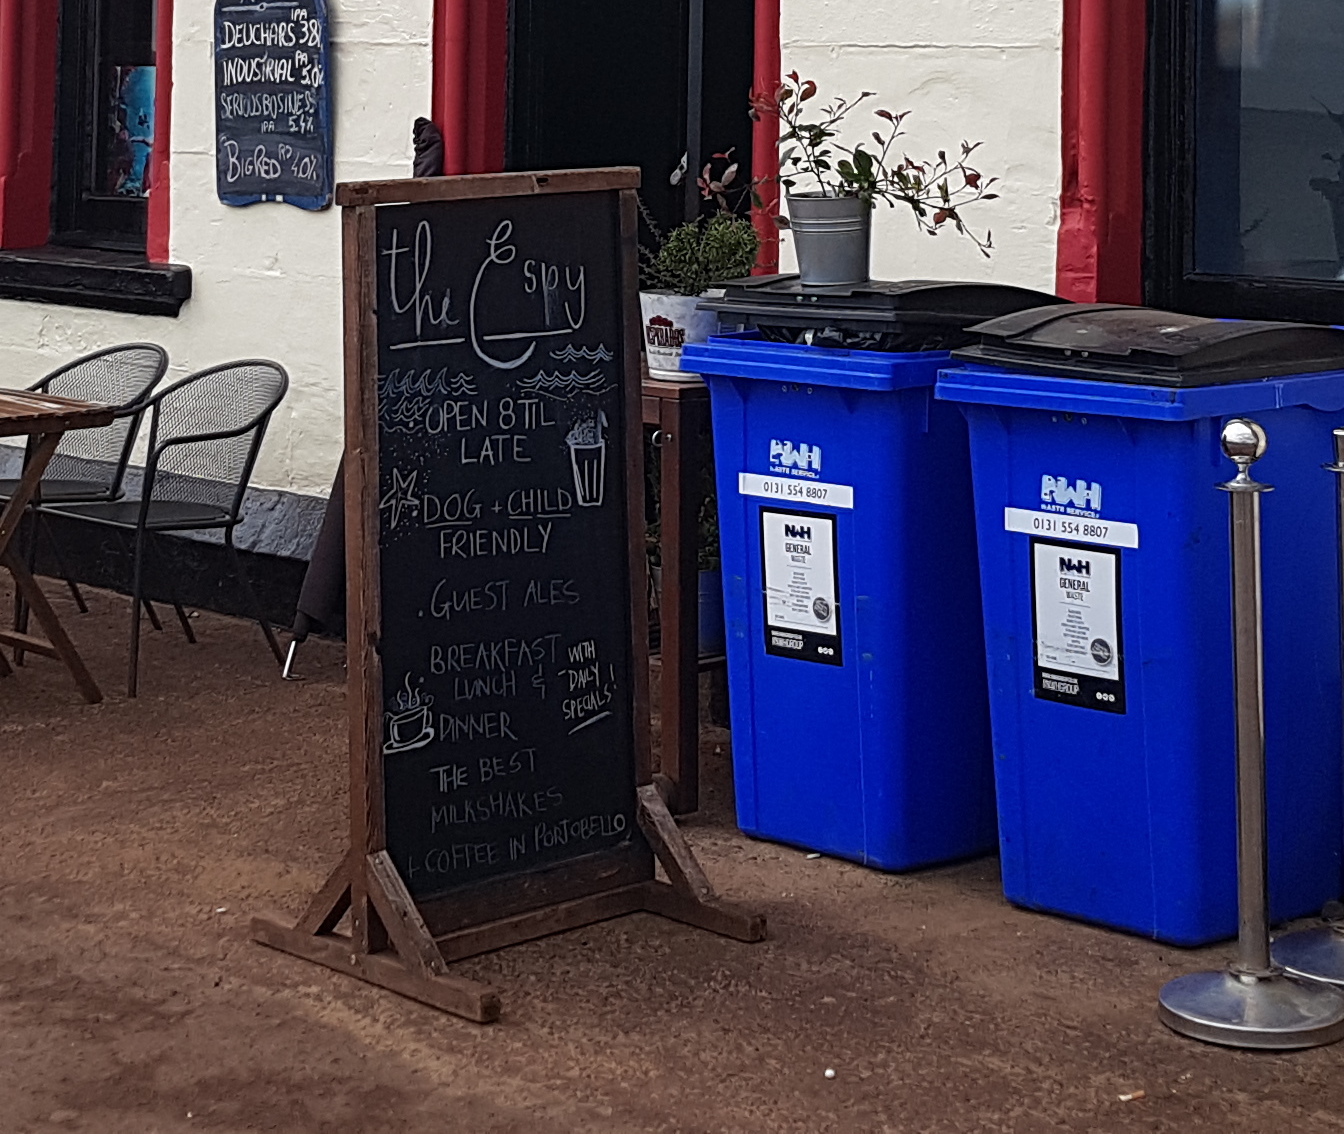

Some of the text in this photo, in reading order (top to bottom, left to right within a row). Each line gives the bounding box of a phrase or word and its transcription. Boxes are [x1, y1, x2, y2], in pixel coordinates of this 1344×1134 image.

[291, 8, 308, 22] IPA
[261, 120, 275, 134] IPA
[382, 220, 586, 369] the Espy
[426, 399, 488, 434] OPEN
[461, 434, 531, 466] LATE
[423, 488, 482, 524] DOG
[508, 488, 572, 515] CHILD
[763, 481, 828, 500] 0131 554 8807
[439, 522, 553, 559] FRIENDLY
[1033, 517, 1109, 539] 0131 554 8807
[784, 542, 812, 556] GENERAL
[430, 579, 580, 620] GUEST ALES
[1059, 577, 1091, 593] GENERAL
[430, 632, 561, 675] BREAKFAST
[567, 639, 596, 663] WITH
[454, 669, 516, 701] LUNCH
[439, 711, 518, 742] DINNER
[430, 747, 536, 793] THE BEST
[430, 785, 563, 834] MILKSHAKES
[425, 840, 499, 874] COFFEE
[509, 833, 526, 861] IN
[534, 813, 626, 852] PORTOBELLO
